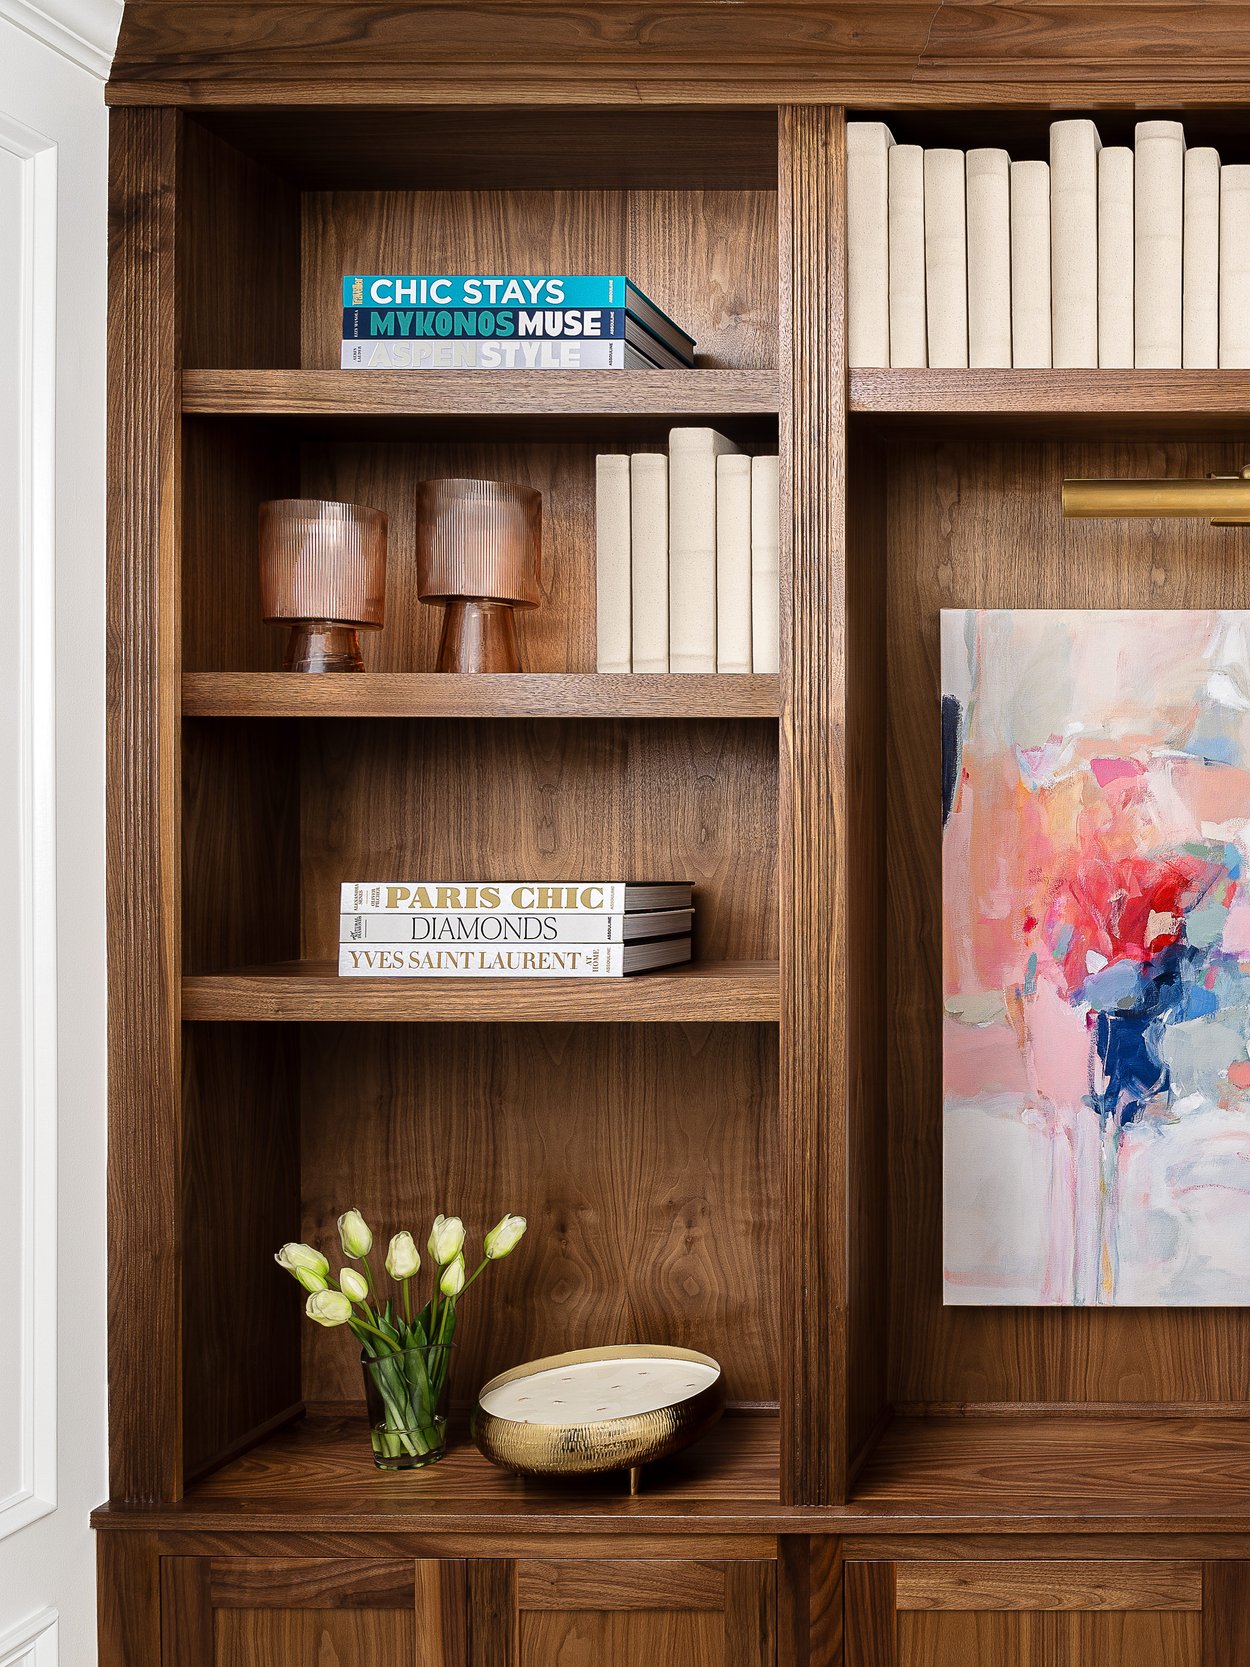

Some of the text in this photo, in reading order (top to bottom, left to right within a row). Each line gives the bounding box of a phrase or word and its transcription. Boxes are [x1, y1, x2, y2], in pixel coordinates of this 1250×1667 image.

[370, 279, 565, 305] CHIC STAYS
[370, 311, 602, 337] MYKONOS MUSE
[368, 342, 582, 368] ASPEN STYLE
[385, 886, 604, 909] PARIS CHIC
[411, 916, 558, 941] DIAMONDS
[348, 951, 582, 970] YVES SAINT LAURENT
[585, 955, 592, 966] AT
[592, 948, 600, 973] HOME
